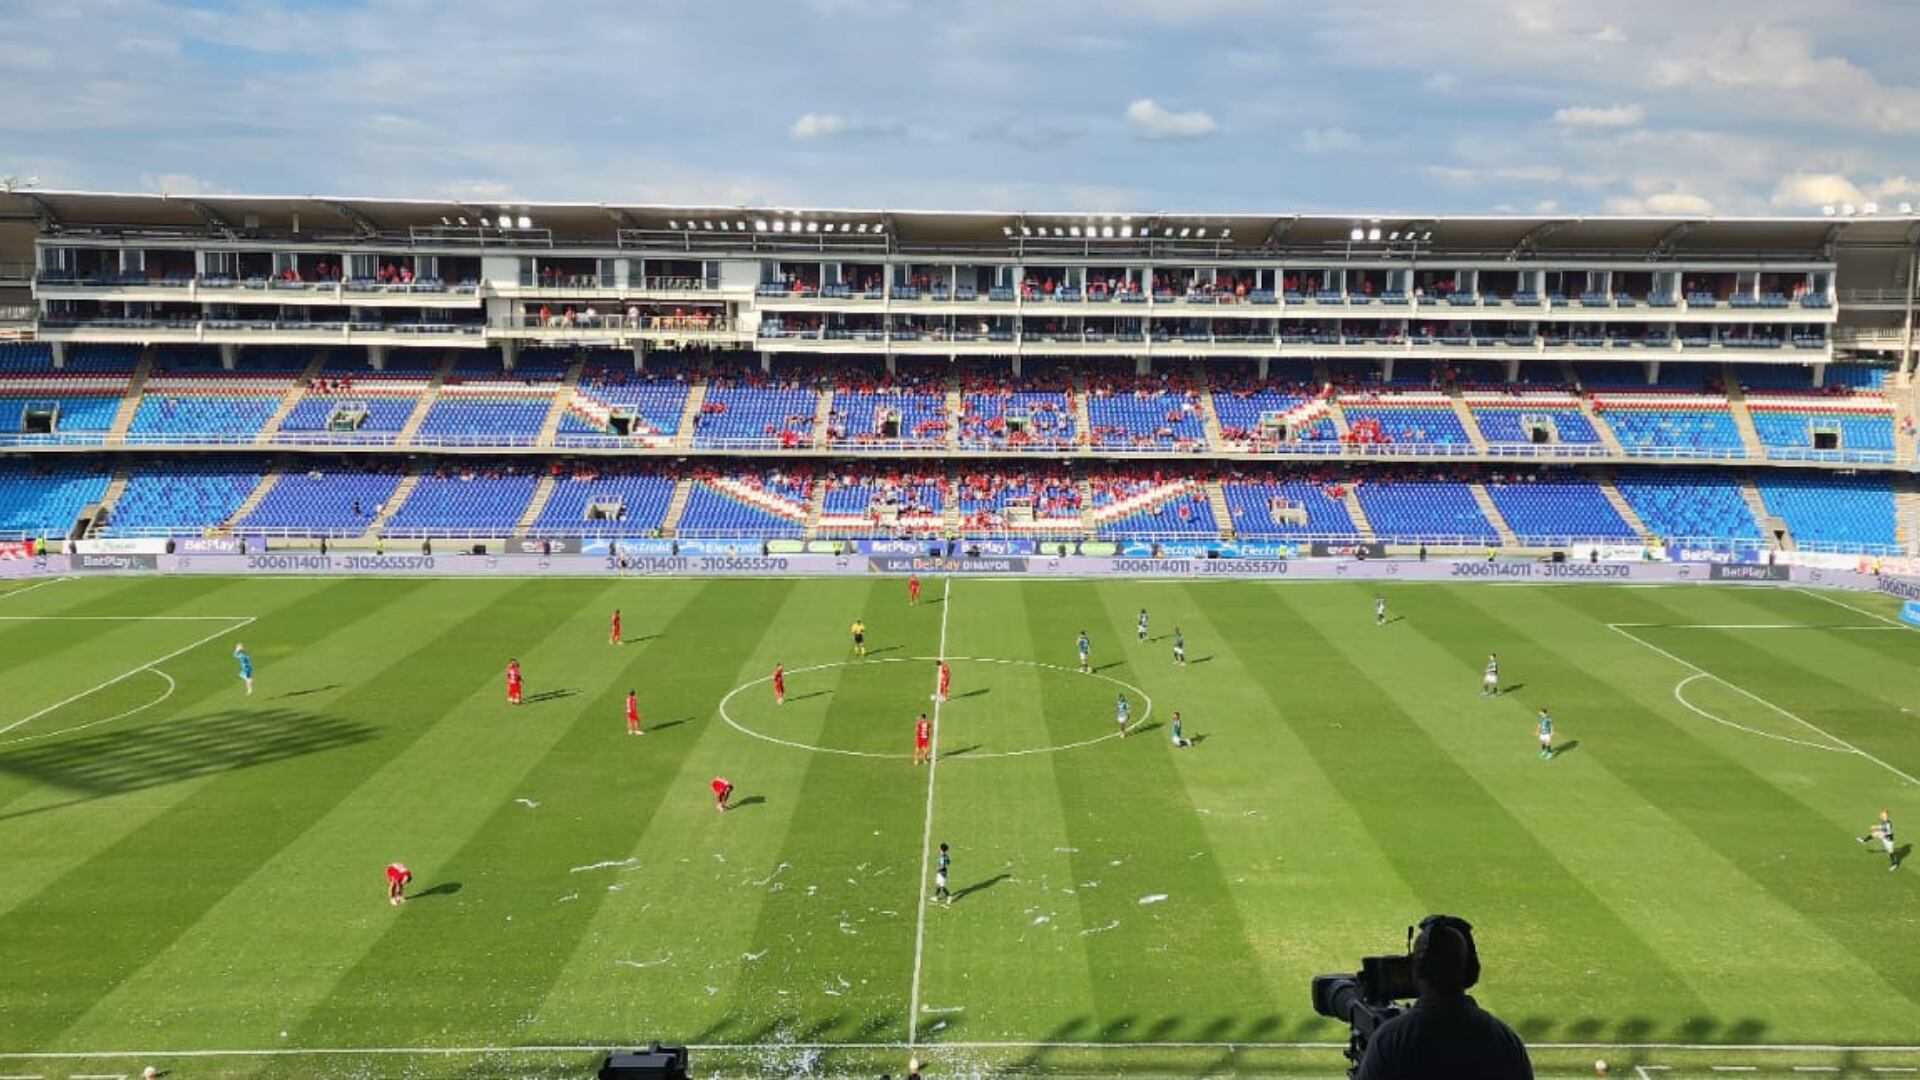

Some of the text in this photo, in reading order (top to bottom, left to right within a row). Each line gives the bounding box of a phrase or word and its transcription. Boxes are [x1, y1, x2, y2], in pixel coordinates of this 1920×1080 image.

[872, 541, 917, 554] BetPlay
[84, 556, 130, 569] BetPlay
[247, 556, 331, 569] 3006114011
[344, 556, 434, 570] 3105655570
[701, 557, 788, 570] 3105655570
[1681, 550, 1730, 564] BetPlay
[1112, 560, 1190, 572] 3006114011
[1203, 560, 1287, 573] 3105655570
[1451, 563, 1531, 576] 3006114011
[1544, 564, 1630, 577] 3105655570
[1722, 566, 1766, 579] BetPlay
